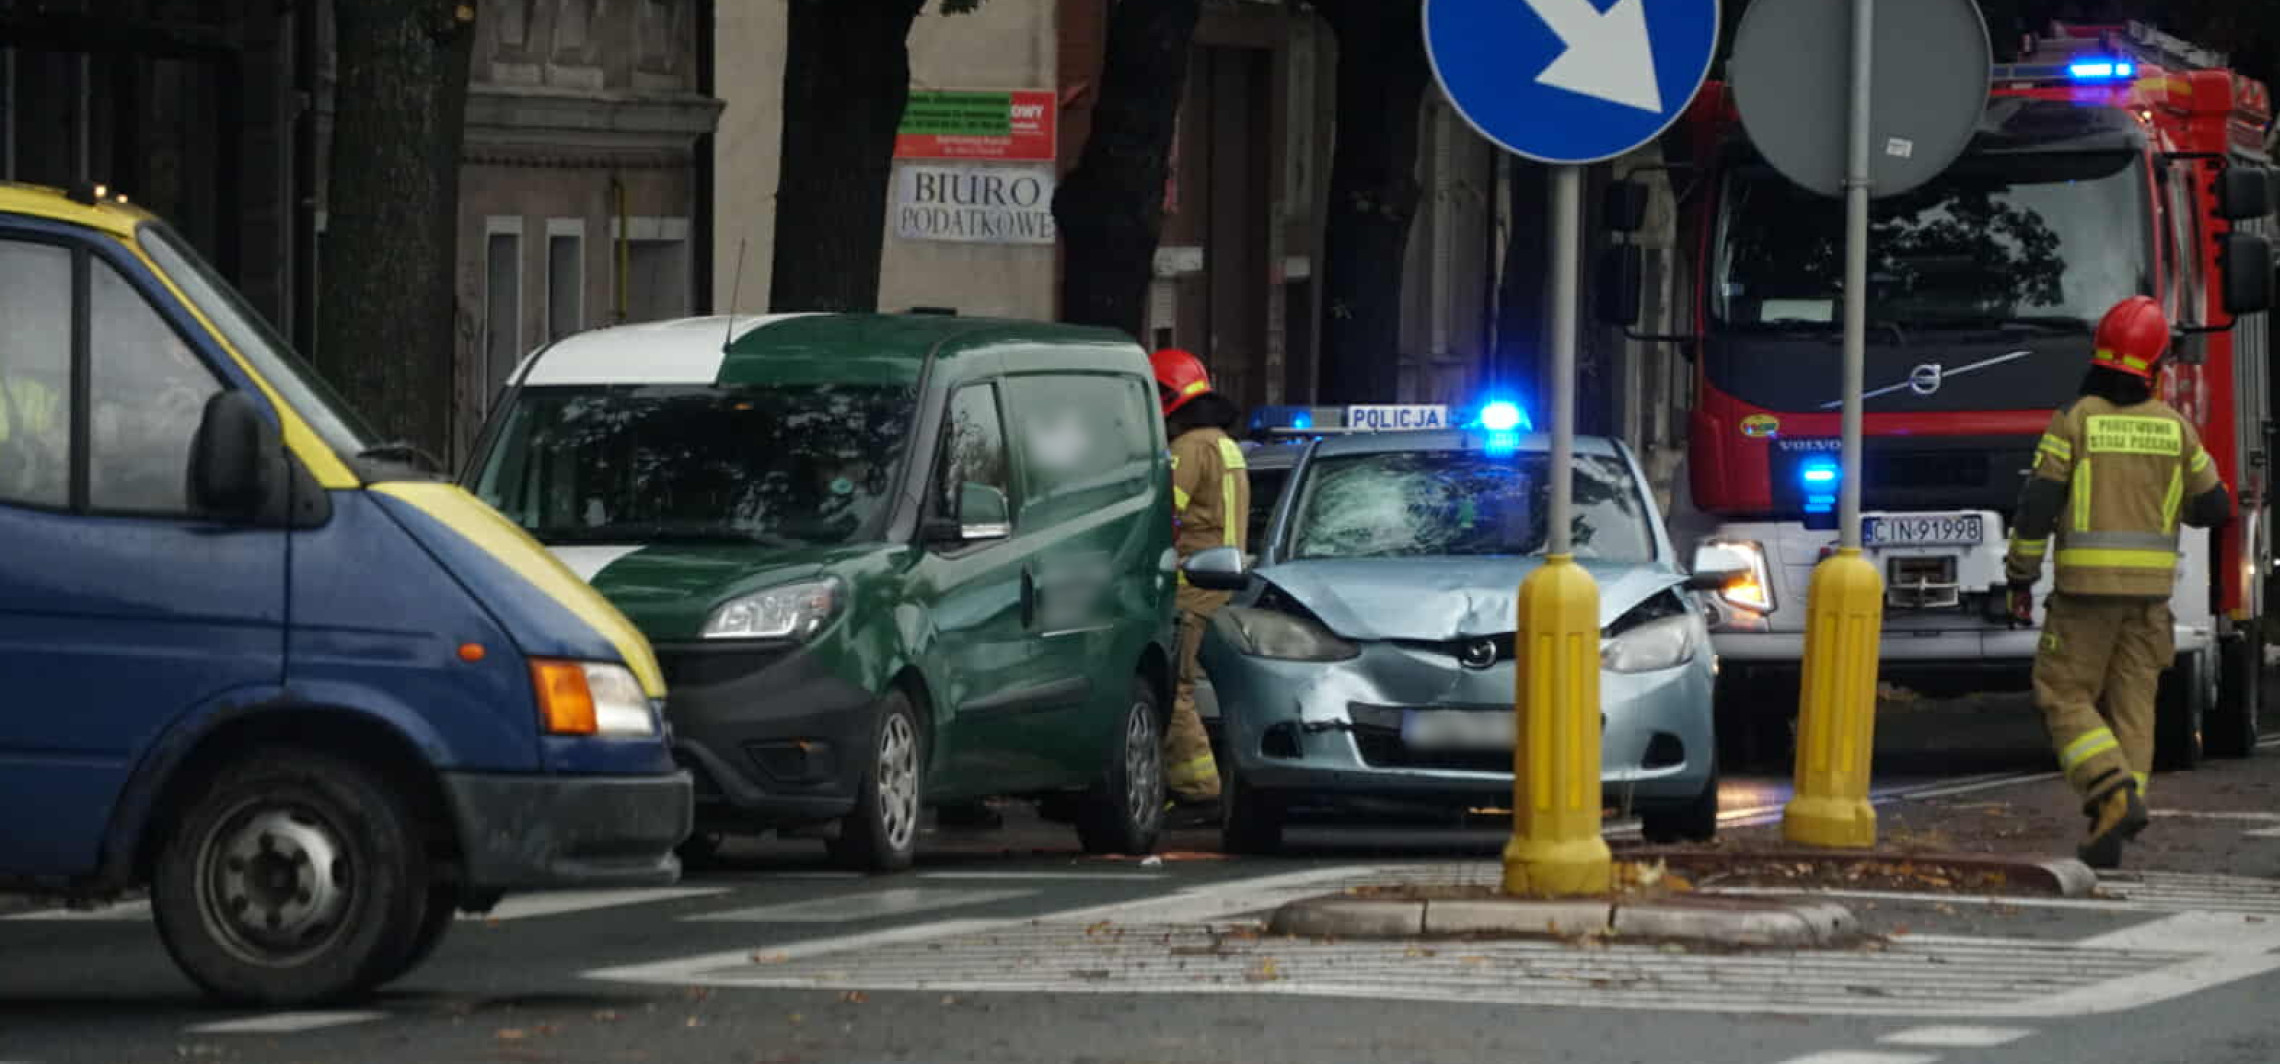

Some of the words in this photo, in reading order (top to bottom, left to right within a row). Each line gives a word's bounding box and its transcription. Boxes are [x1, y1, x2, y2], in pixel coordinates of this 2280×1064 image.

[915, 172, 1041, 207] BIURO
[902, 206, 1055, 238] PODATKOWE
[1353, 408, 1440, 429] POLICJA
[1779, 439, 1842, 450] VOLVO
[1918, 519, 1978, 540] 91998
